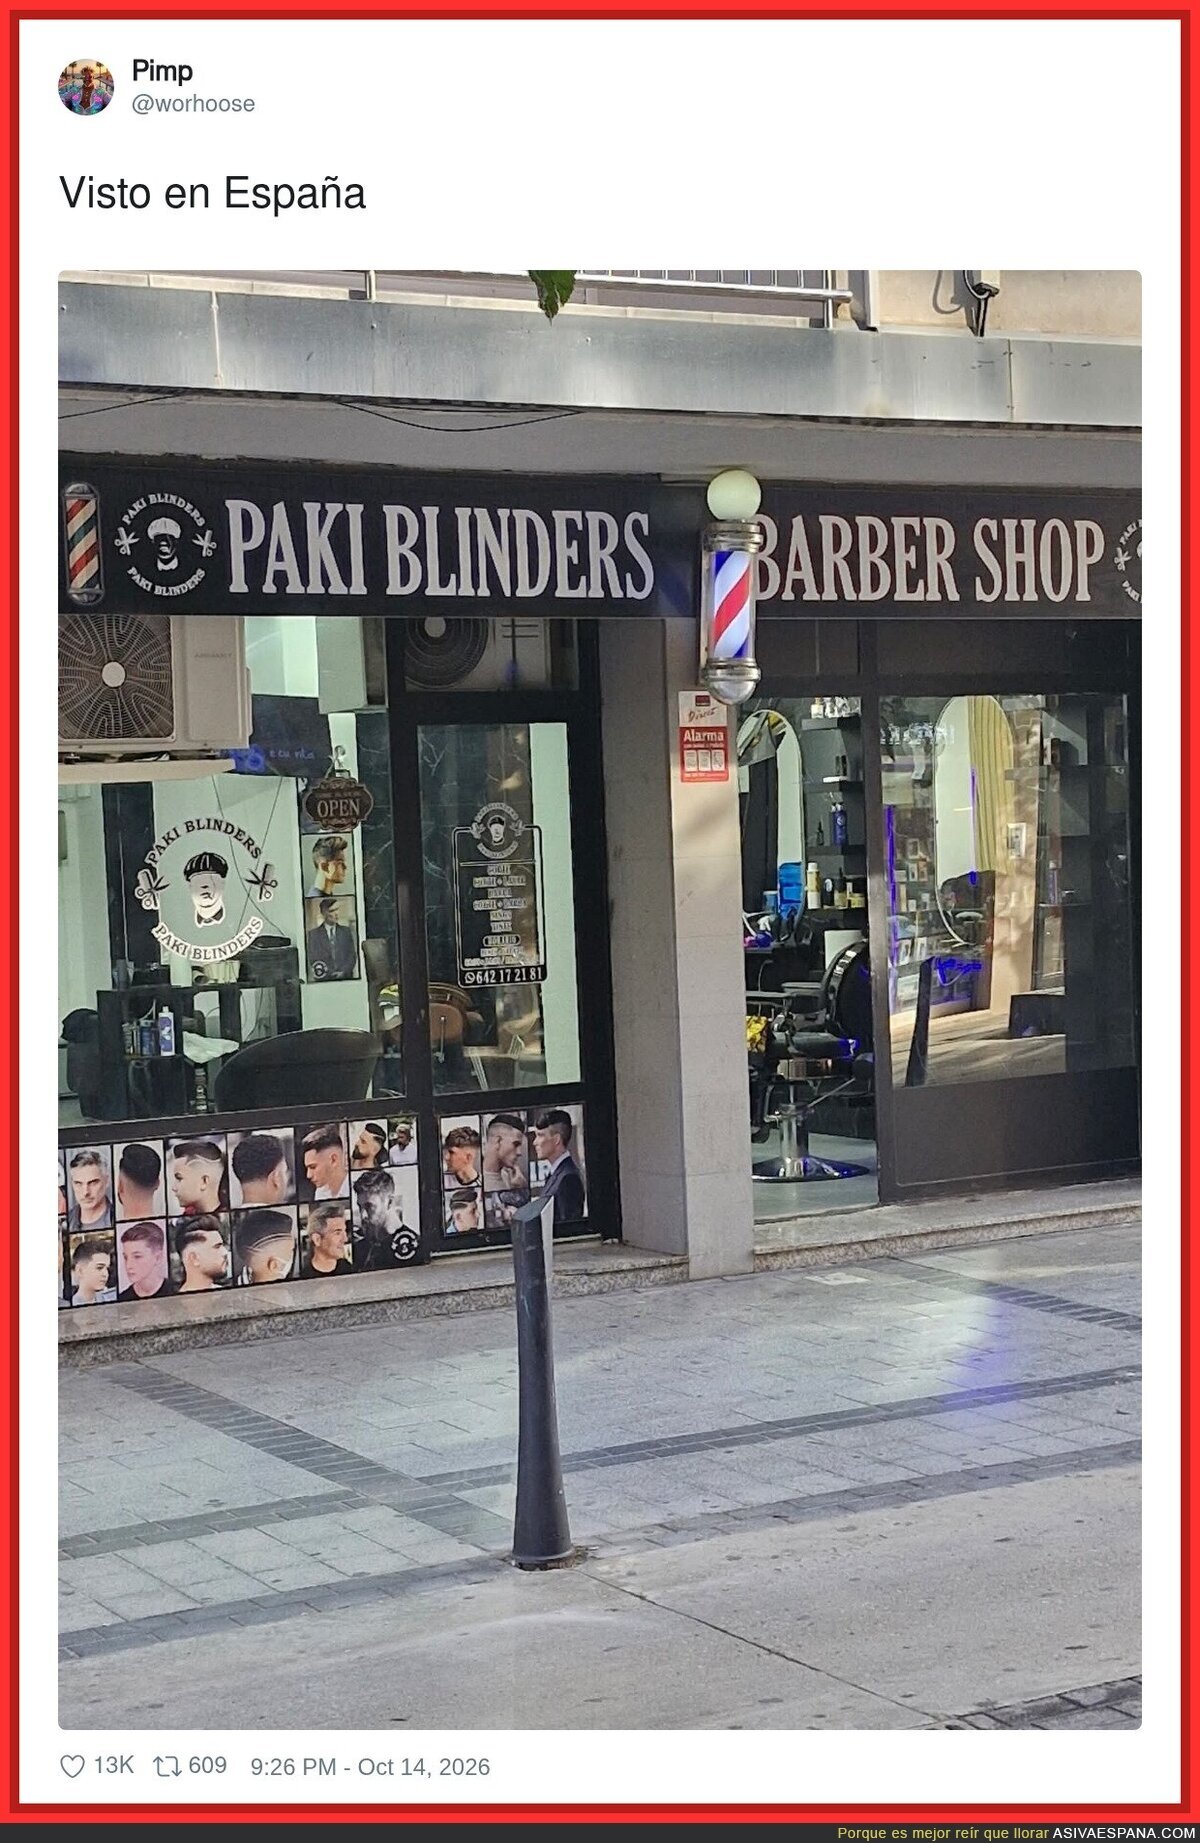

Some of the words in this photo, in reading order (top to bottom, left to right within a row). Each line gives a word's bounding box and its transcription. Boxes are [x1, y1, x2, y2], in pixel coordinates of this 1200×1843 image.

[122, 497, 147, 525] PAKI
[148, 493, 206, 527] BLINDERS
[225, 499, 368, 595] PAKI
[383, 505, 655, 601] BLINDERS
[754, 513, 961, 602] BARBER
[973, 517, 1105, 603] SHOP
[127, 566, 153, 592] PAKI
[154, 568, 206, 596] BLINDERS
[683, 728, 724, 742] Alarma
[317, 799, 360, 818] OPEN
[145, 826, 181, 867] PAKI
[185, 817, 263, 860] BLINDERS
[154, 923, 189, 957] PAKI
[191, 917, 263, 961] BLINDERS
[476, 970, 496, 984] 642
[500, 969, 511, 982] 17
[514, 968, 526, 981] 21
[530, 967, 542, 980] 81
